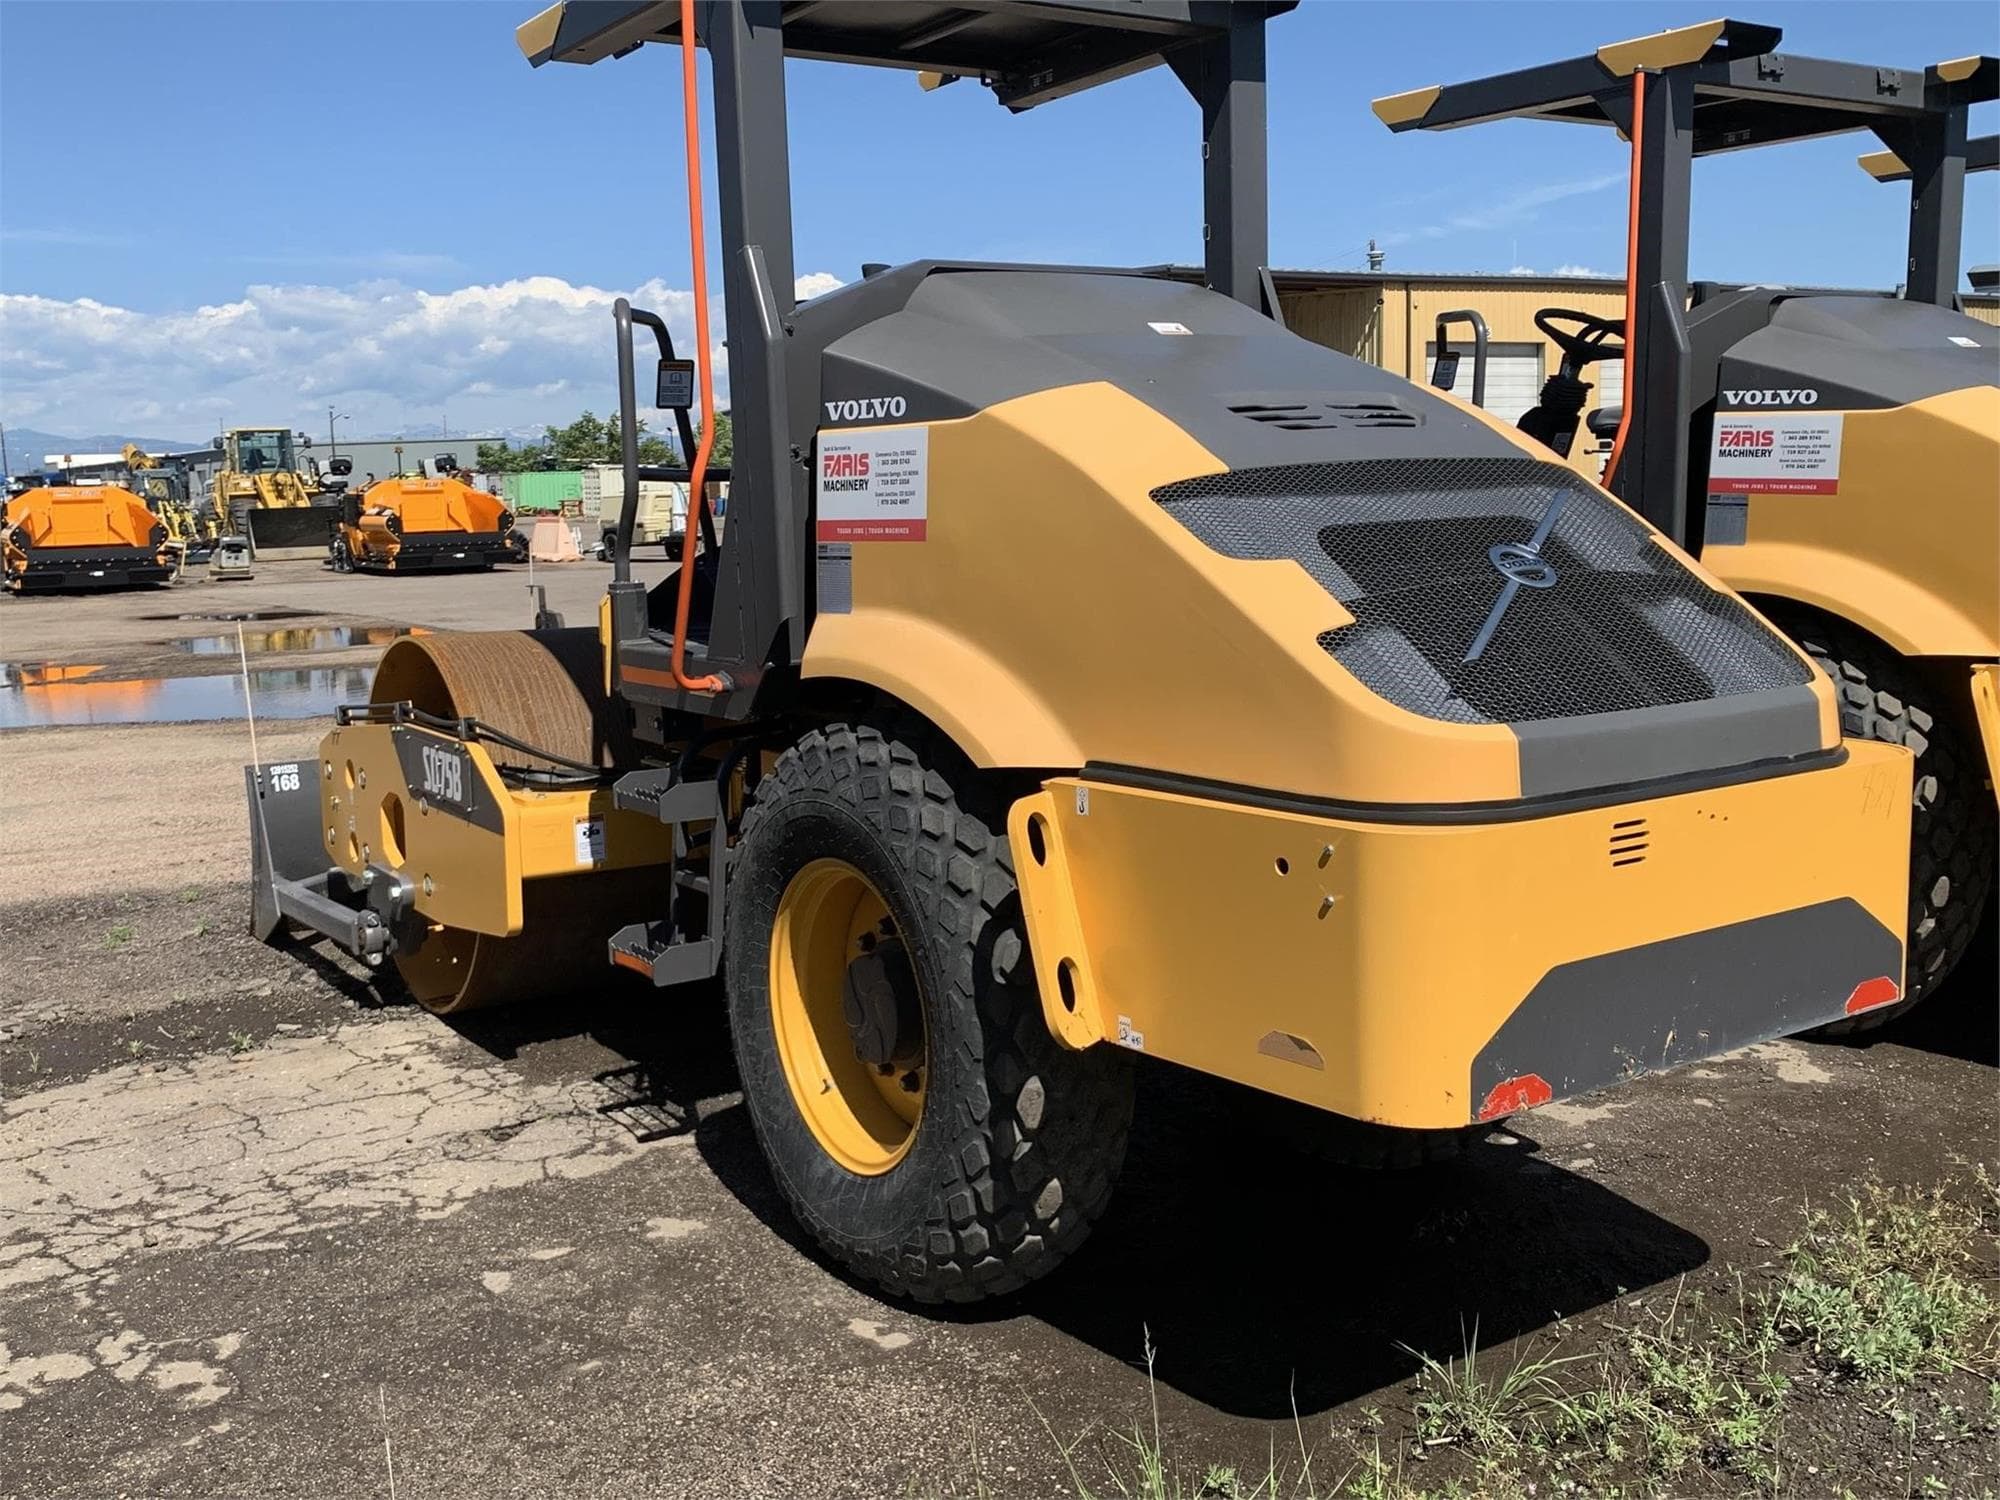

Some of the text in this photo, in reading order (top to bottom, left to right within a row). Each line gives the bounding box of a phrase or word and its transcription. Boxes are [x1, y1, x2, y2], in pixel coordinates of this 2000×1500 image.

[1723, 389, 1818, 405] VOLVO
[825, 396, 907, 421] VOLVO
[1719, 430, 1774, 448] FARIS
[1718, 448, 1774, 458] MACHINERY
[824, 452, 870, 478] FARIS
[824, 478, 870, 492] MACHINERY
[422, 745, 463, 802] SD75B
[271, 774, 300, 793] 168
